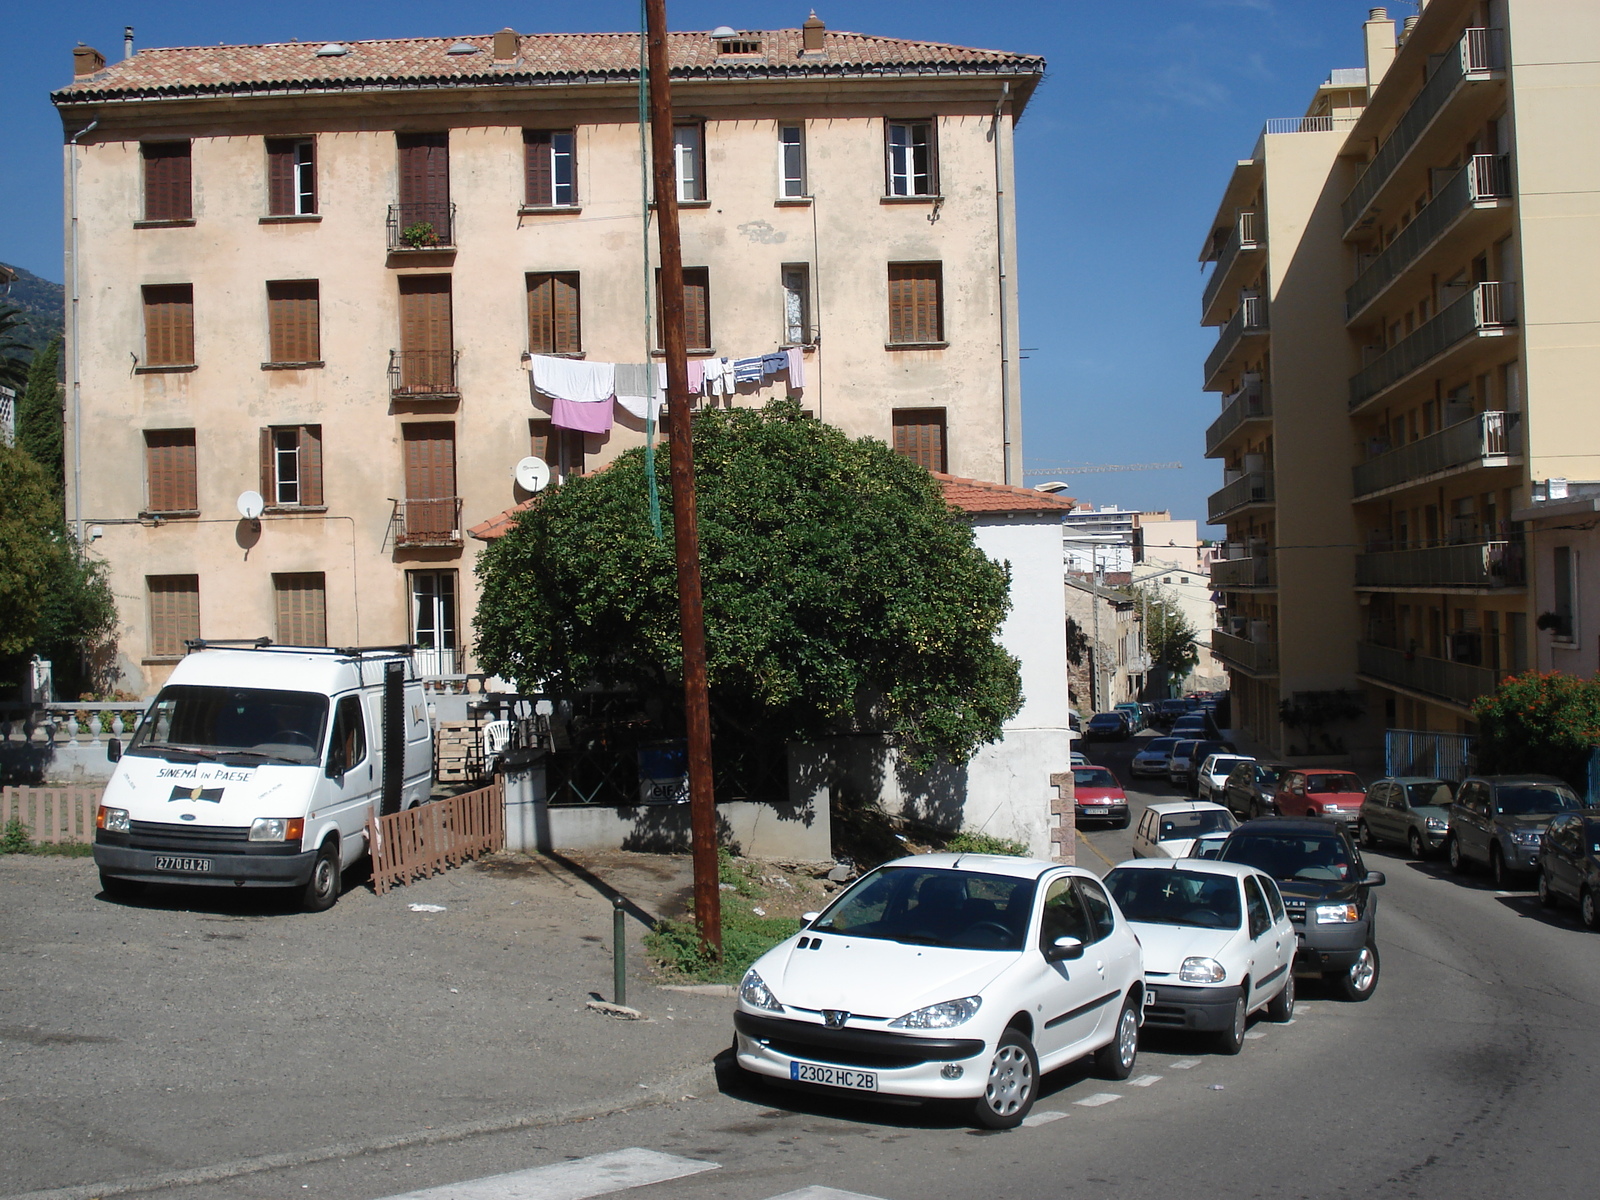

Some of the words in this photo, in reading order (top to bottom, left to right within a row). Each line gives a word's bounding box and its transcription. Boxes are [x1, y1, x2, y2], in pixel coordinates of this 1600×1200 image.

[156, 768, 198, 779] SINEMA
[214, 769, 253, 782] PAESE
[653, 785, 674, 797] elf
[157, 857, 182, 870] 2770
[183, 859, 195, 870] GA
[196, 860, 209, 871] 2B
[800, 1065, 833, 1084] 2302
[836, 1070, 853, 1087] HC
[856, 1073, 874, 1089] 2B
